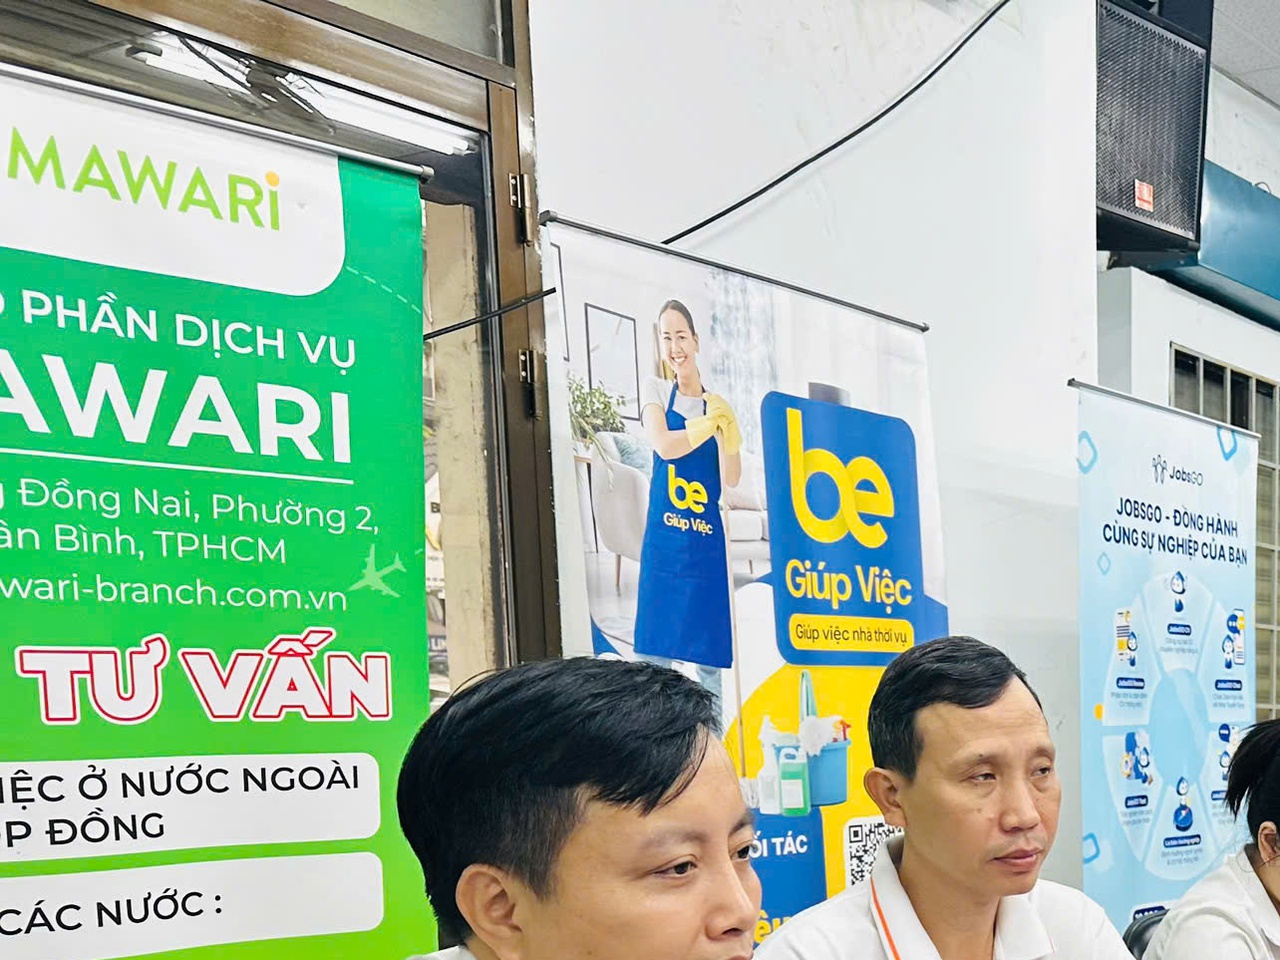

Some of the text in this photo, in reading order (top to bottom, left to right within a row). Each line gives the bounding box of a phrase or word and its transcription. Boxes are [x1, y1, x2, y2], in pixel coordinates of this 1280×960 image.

[21, 290, 158, 342] PHẦN
[175, 313, 285, 361] DỊCH
[297, 331, 356, 376] VỤ
[667, 464, 709, 514] be
[786, 407, 895, 549] be
[1169, 466, 1204, 486] JobsGO
[17, 478, 121, 519] Đồng
[135, 487, 200, 522] Nai,
[211, 494, 347, 535] Phường
[355, 505, 380, 536] 2,
[664, 512, 713, 538] Giúp Việc
[1116, 497, 1163, 524] JOBSGO
[1172, 505, 1204, 532] ĐỒNG
[1206, 513, 1238, 538] HÀNH
[55, 523, 145, 561] Bình,
[153, 530, 288, 564] TPHCM
[1102, 520, 1248, 568] CÙNG SỰ NGHIỆP CỦA BẠN
[0, 573, 348, 613] wari-branch.com.vn
[785, 559, 912, 614] Giúp Việc
[795, 624, 820, 643] Giúp
[822, 625, 850, 645] việc
[894, 632, 908, 647] vụ
[15, 627, 392, 725] TƯ VẤN
[78, 765, 108, 801] Ở
[121, 763, 231, 798] NƯỚC
[243, 760, 360, 792] NGOÀI
[0, 807, 166, 848] P ĐỒNG
[749, 830, 808, 858] ỐI TÁC
[0, 900, 83, 936] CÁC
[96, 888, 204, 928] NƯỚC
